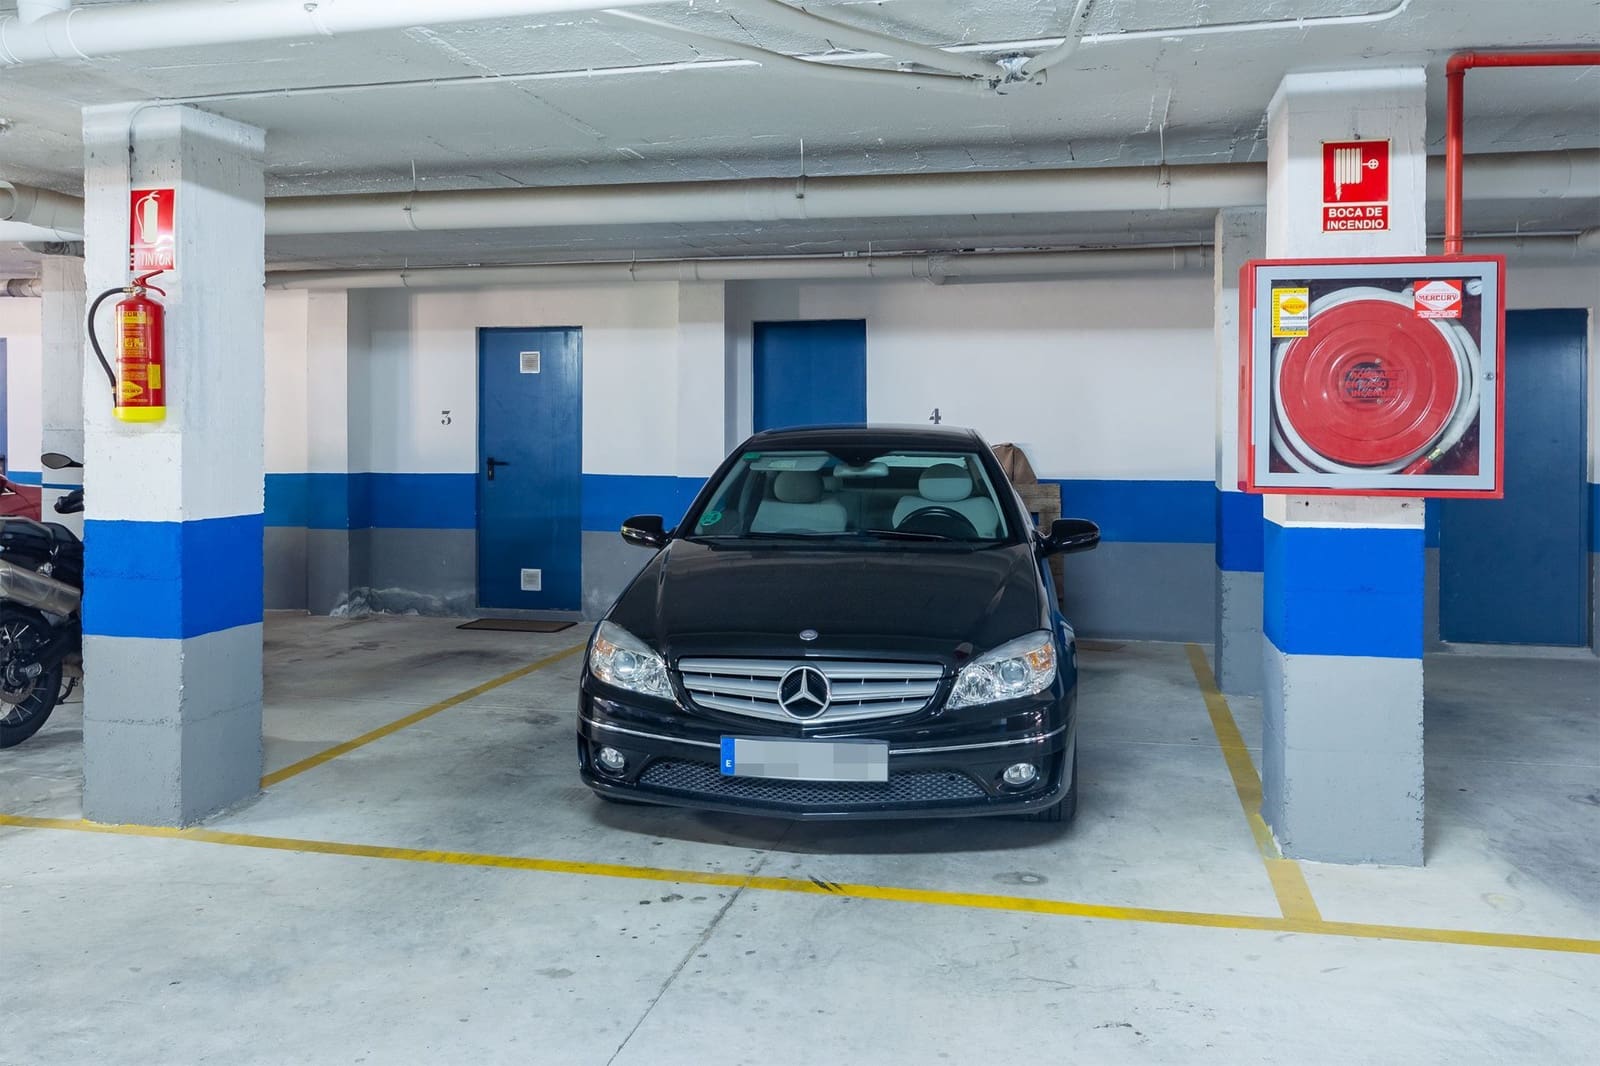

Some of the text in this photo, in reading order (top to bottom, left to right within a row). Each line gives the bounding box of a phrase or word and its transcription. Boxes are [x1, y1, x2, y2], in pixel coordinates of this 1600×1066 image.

[1328, 207, 1383, 218] BOCA DE
[1327, 219, 1385, 230] INCENDIO
[1417, 293, 1458, 301] MERCURY
[441, 410, 451, 426] 3
[929, 408, 942, 425] 4
[725, 759, 732, 768] E
